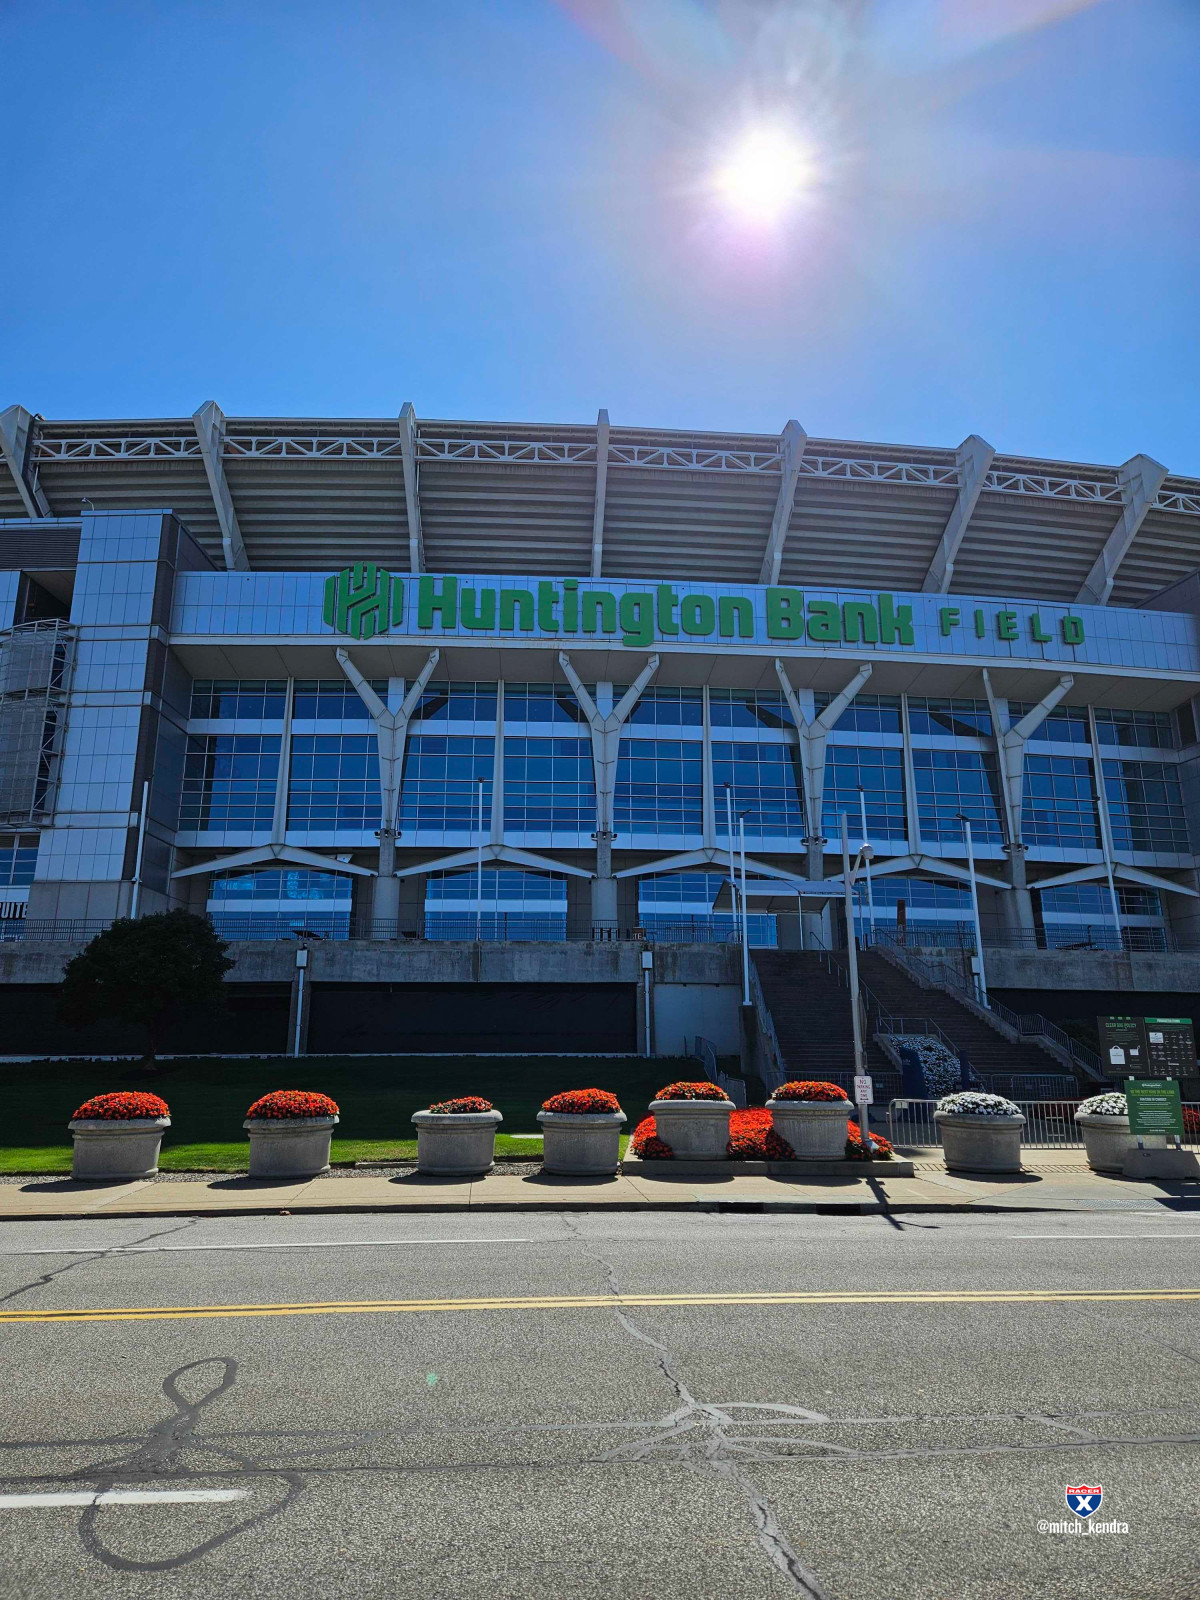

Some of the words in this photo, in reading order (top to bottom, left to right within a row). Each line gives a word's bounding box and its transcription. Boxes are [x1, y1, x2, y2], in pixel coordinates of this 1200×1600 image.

[418, 575, 754, 647] Huntington
[766, 587, 914, 645] Bank
[940, 607, 1085, 644] FIELD
[0, 902, 28, 919] UITE
